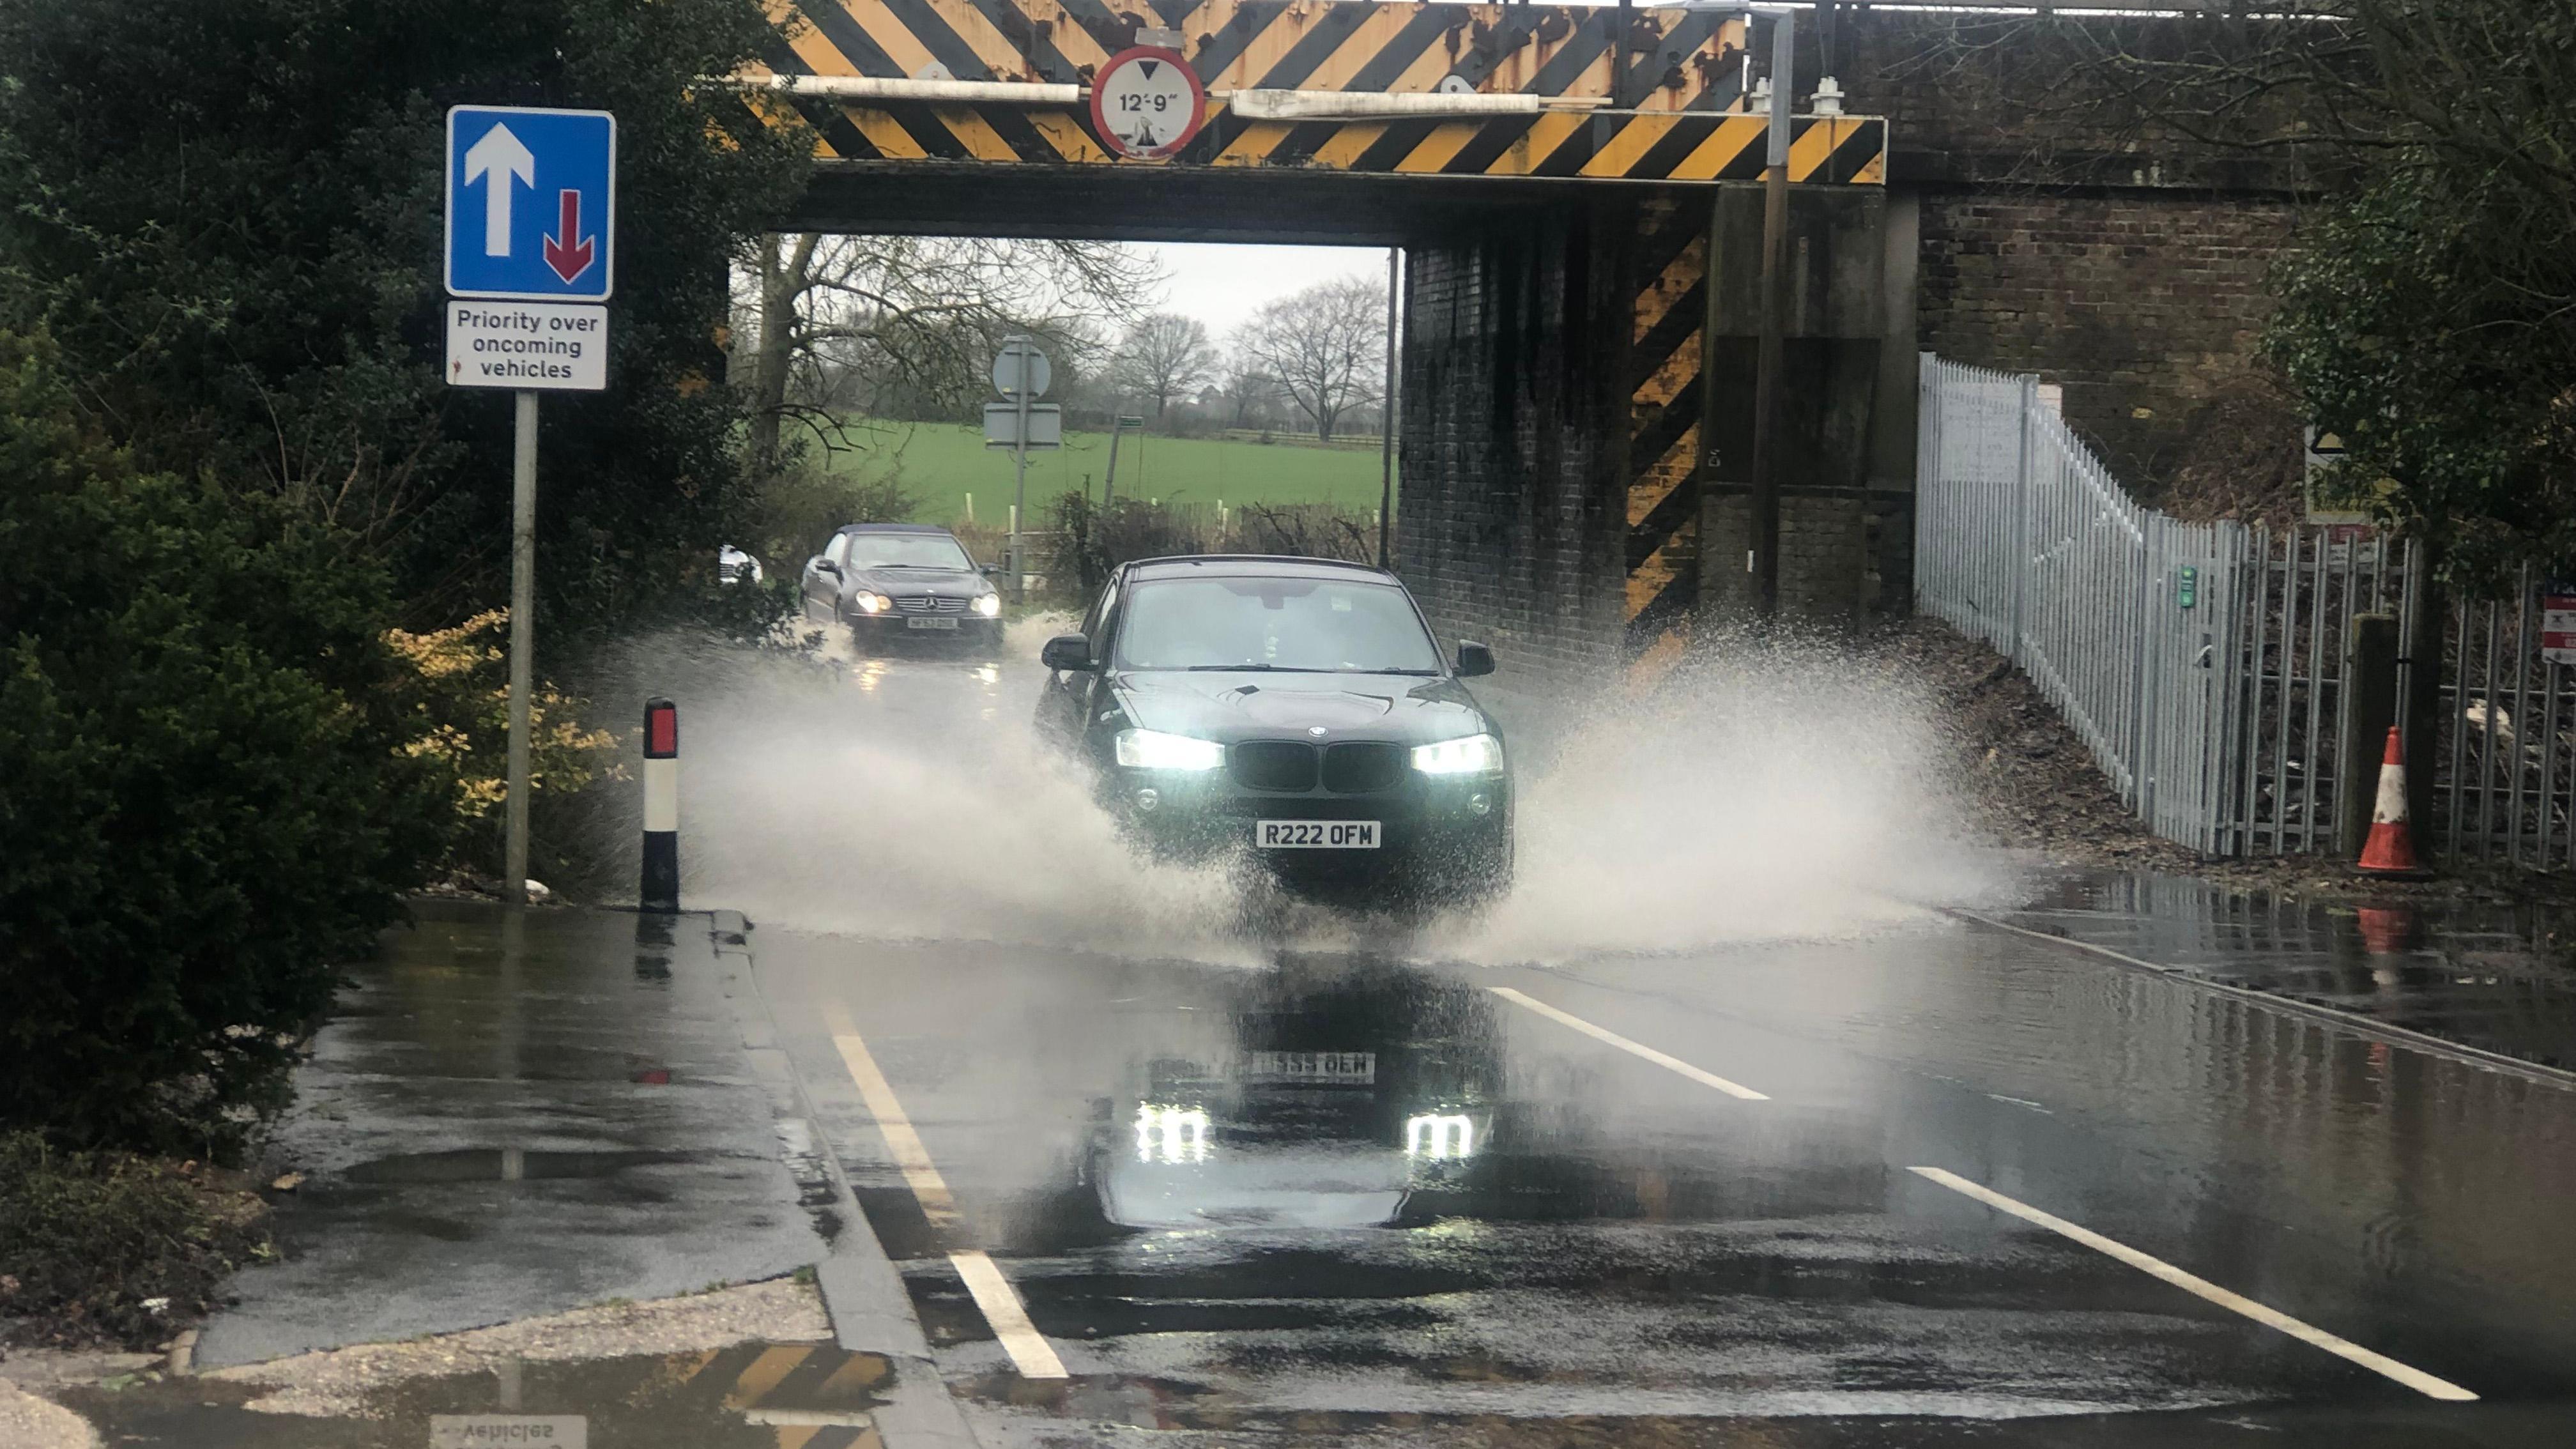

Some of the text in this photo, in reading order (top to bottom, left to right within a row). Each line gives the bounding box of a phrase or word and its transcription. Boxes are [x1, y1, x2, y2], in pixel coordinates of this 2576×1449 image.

[457, 309, 598, 333] Priority over
[473, 336, 581, 358] oncoming
[480, 358, 571, 378] vehicles
[1266, 824, 1372, 845] R222 OFM
